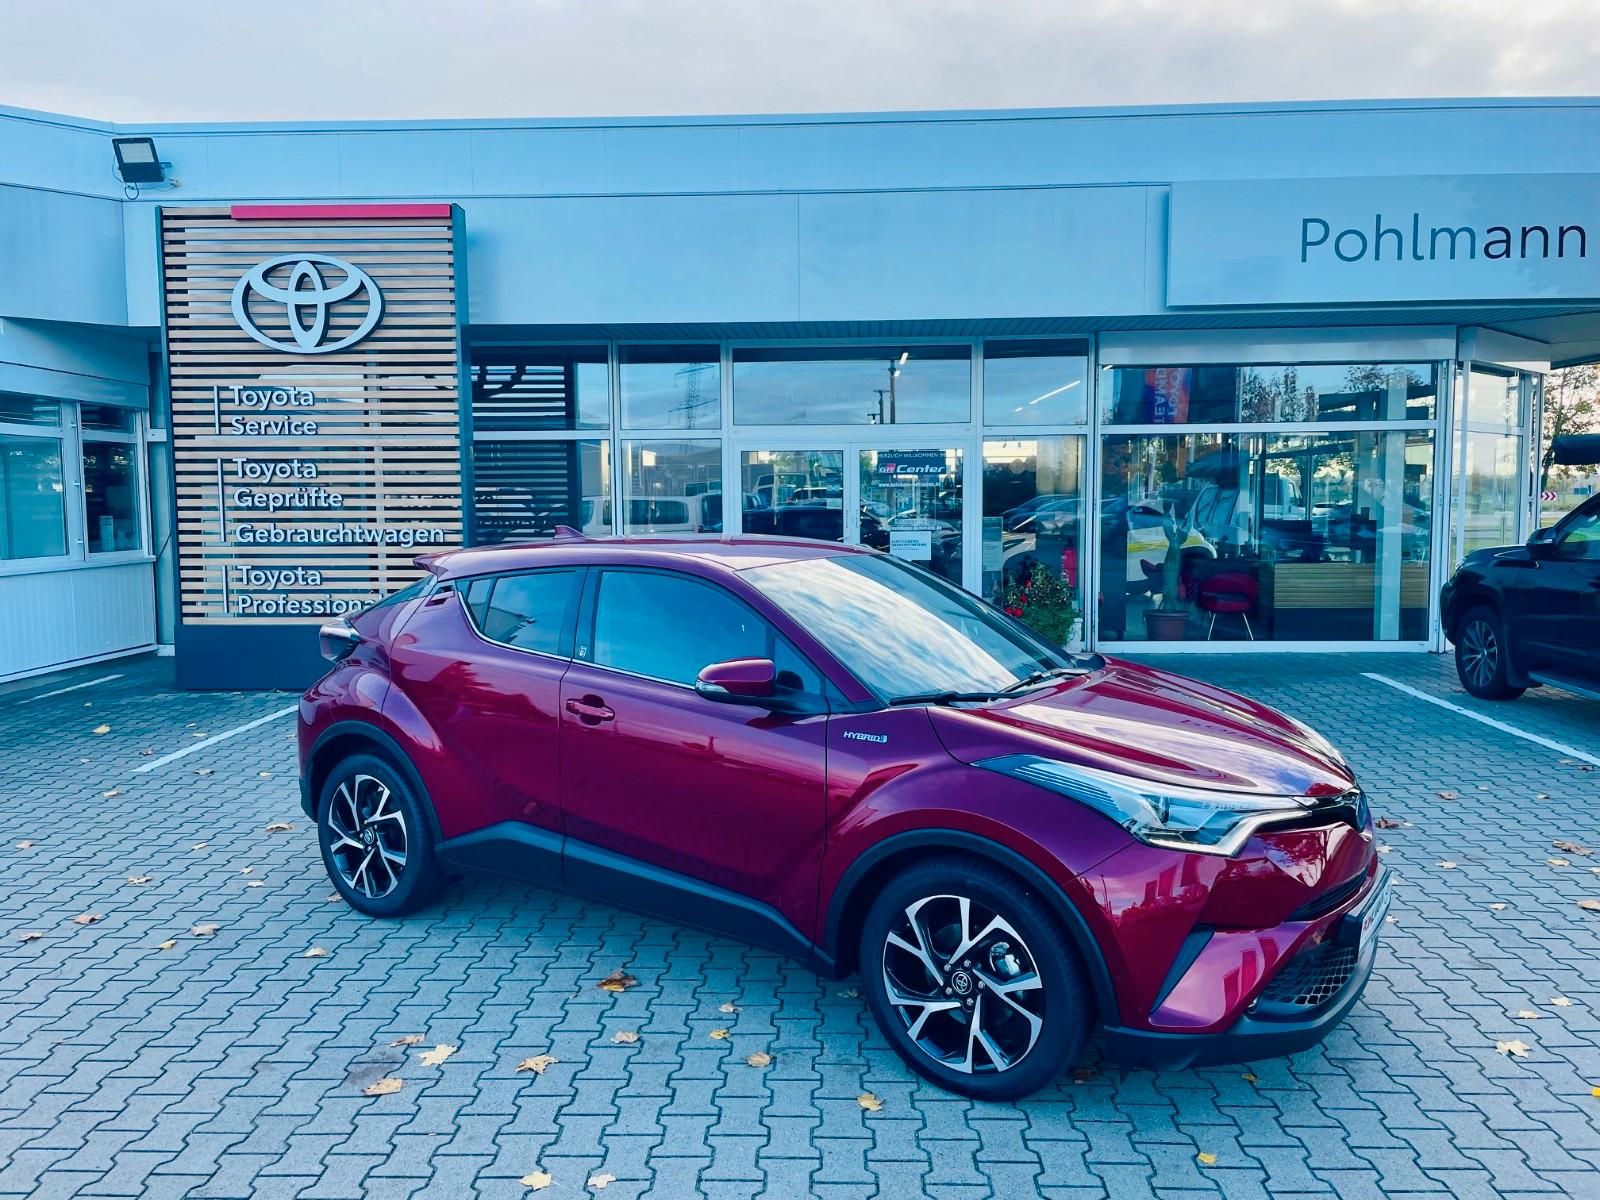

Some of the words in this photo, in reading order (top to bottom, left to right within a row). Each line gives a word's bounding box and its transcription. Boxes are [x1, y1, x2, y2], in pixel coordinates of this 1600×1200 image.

[1300, 213, 1587, 263] Pohlmann
[229, 386, 315, 411] Toyota
[231, 416, 318, 435] Service
[232, 457, 318, 483] Toyota
[896, 464, 945, 473] Center
[233, 487, 343, 513] Geprüfte
[235, 523, 445, 548] Gebrauchtwagen
[237, 566, 322, 590] Toyota
[843, 731, 881, 743] HYBRID
